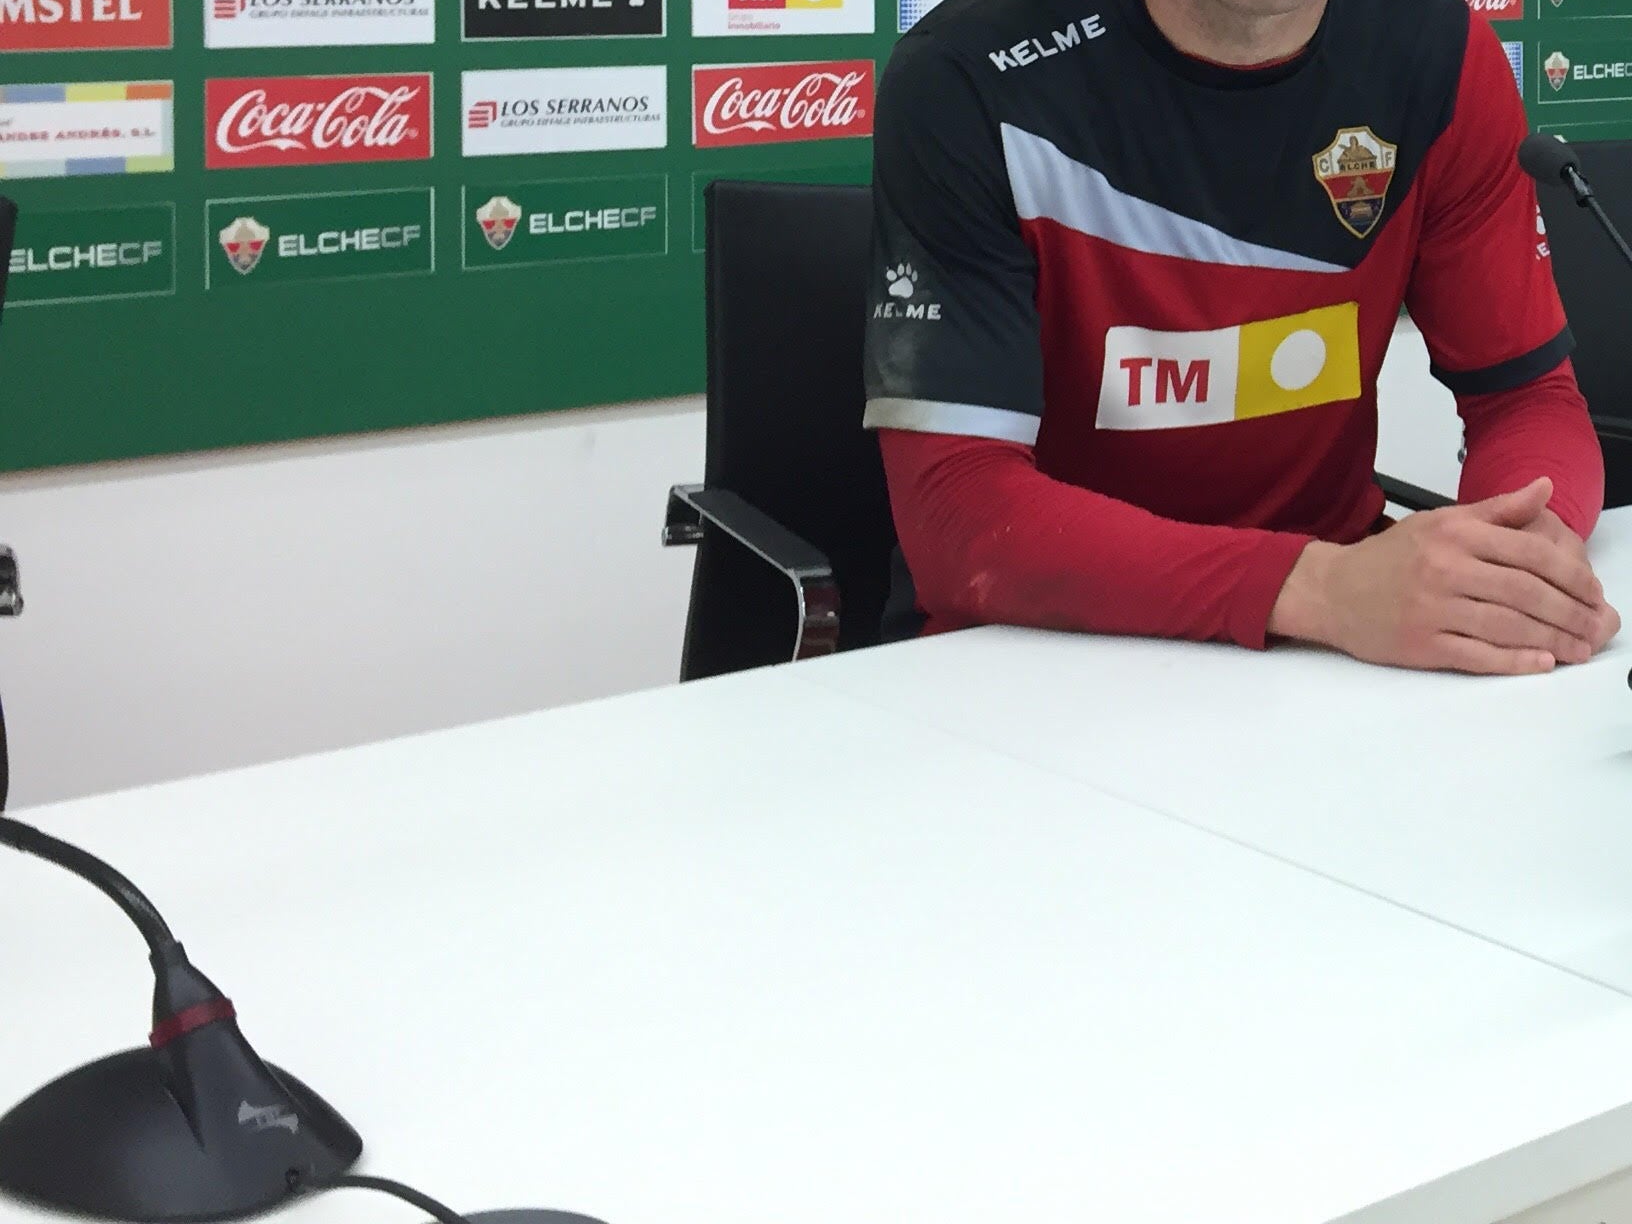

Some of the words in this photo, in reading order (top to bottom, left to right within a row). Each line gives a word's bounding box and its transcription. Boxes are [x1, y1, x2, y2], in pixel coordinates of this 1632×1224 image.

[988, 14, 1108, 73] KELME
[215, 86, 421, 153] Coca-Cola
[501, 100, 540, 117] LOS
[546, 96, 650, 115] SERRANOS
[703, 71, 867, 134] Coca-Cola
[278, 225, 421, 257] ELCHECF
[528, 206, 657, 234] ELCHECF
[9, 241, 162, 274] ELCHECF
[1120, 357, 1211, 408] TM
